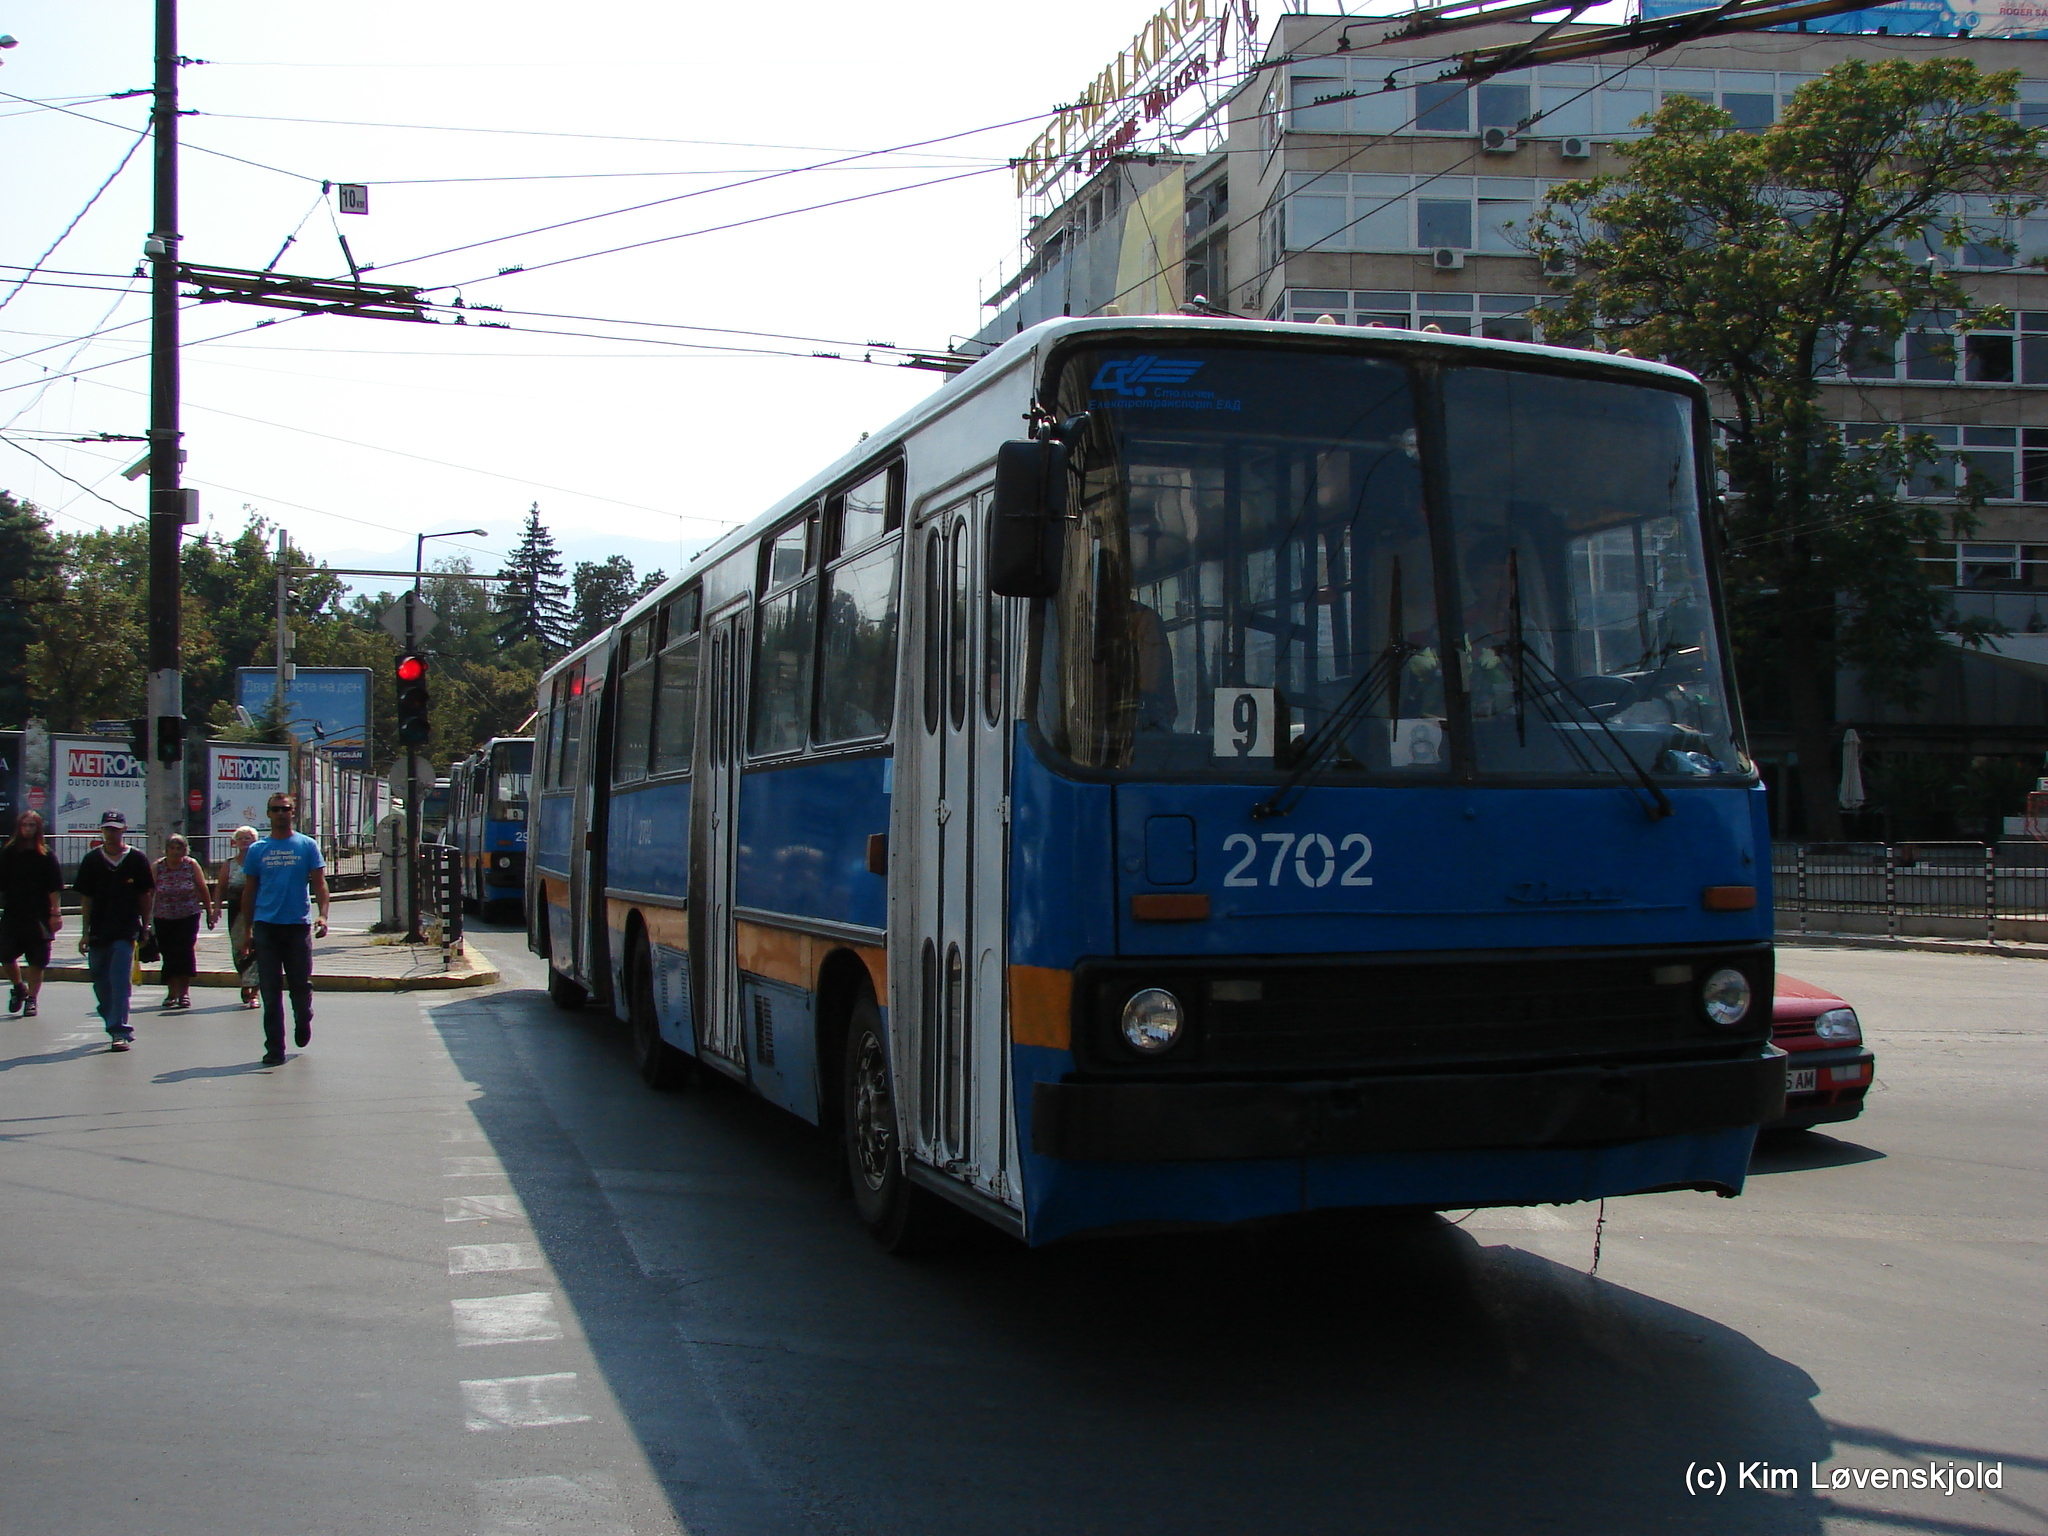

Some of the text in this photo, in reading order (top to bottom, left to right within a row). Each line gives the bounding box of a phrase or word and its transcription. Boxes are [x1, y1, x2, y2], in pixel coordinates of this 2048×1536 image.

[1999, 7, 2033, 17] ROGER
[1017, 0, 1210, 198] KEEP WALKING
[342, 189, 356, 208] 10
[1154, 387, 1215, 399] Столичен
[1216, 400, 1242, 412] ЕАД
[243, 680, 269, 693] Два
[319, 682, 335, 693] на
[337, 682, 362, 695] ден
[1232, 693, 1258, 757] 9
[218, 758, 280, 779] METROPOLIS
[68, 779, 110, 787] OUTDOOR
[113, 780, 140, 788] MEDIA
[217, 782, 243, 790] OUTDOOR
[1222, 832, 1373, 888] 2702
[1795, 1071, 1814, 1089] AM
